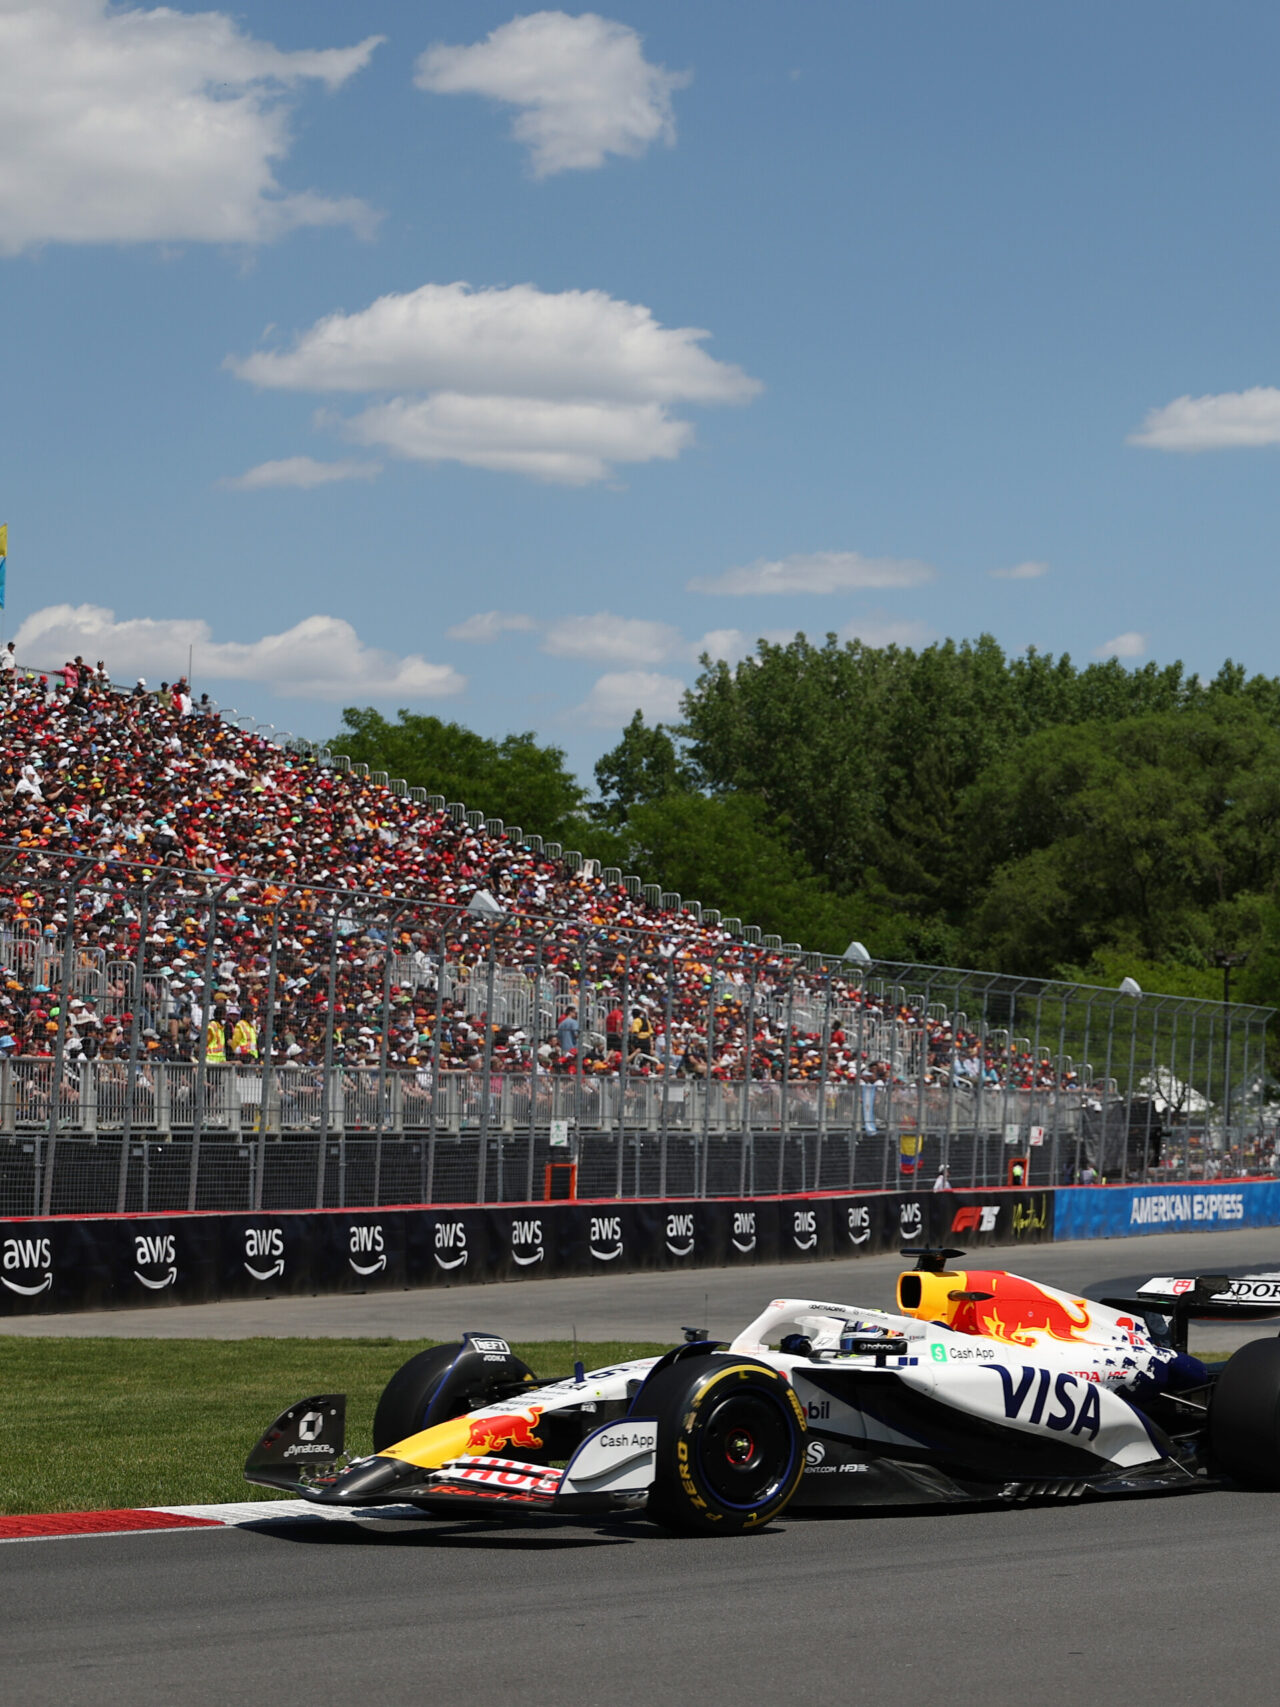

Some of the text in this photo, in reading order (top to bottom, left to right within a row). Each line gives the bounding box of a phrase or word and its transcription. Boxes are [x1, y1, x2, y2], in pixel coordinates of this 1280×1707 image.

[848, 1206, 870, 1228] aws
[900, 1203, 922, 1223] aws
[1131, 1194, 1244, 1224] AMERICAN EXPRESS
[512, 1220, 543, 1244] aws
[591, 1217, 621, 1241] aws
[666, 1214, 694, 1237] aws
[733, 1212, 755, 1234] aws
[794, 1211, 816, 1232] aws
[245, 1228, 283, 1256] aws
[350, 1226, 384, 1252] aws
[435, 1222, 466, 1248] aws
[4, 1239, 51, 1269] aws
[135, 1235, 176, 1264] aws
[949, 1346, 994, 1361] Cash App
[1067, 1371, 1101, 1383] NDA
[978, 1364, 1101, 1442] VISA
[288, 1444, 330, 1456] dynatrace
[600, 1433, 655, 1448] Cash App
[461, 1458, 563, 1491] HUG
[677, 1441, 707, 1508] ZERO
[429, 1485, 508, 1500] Red
